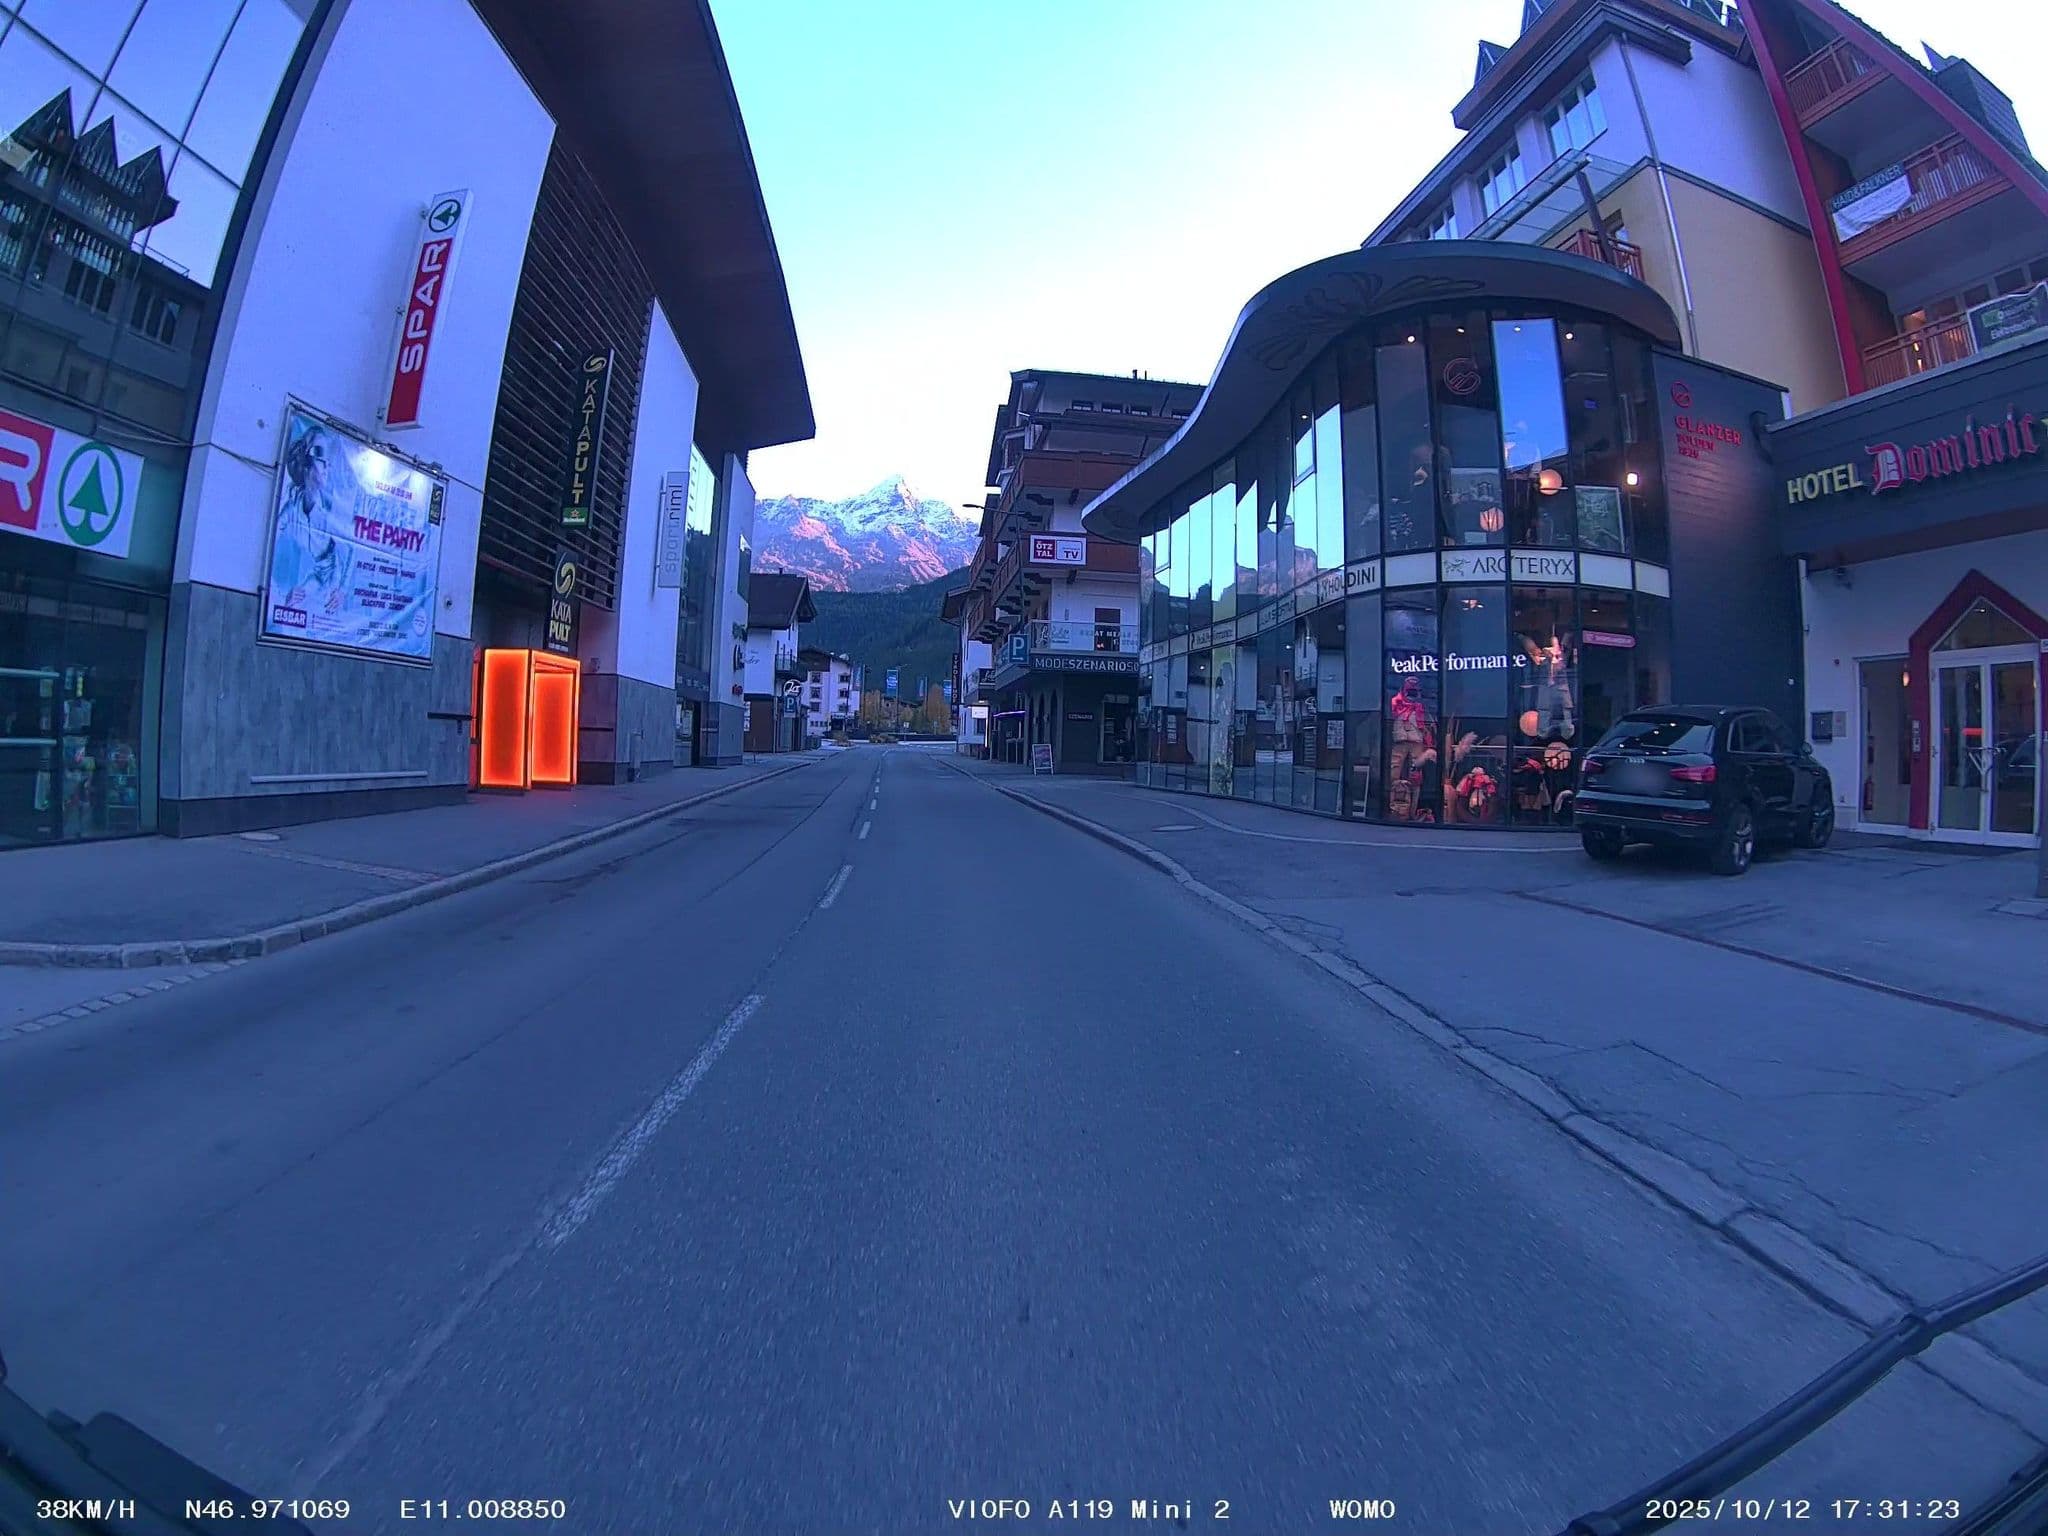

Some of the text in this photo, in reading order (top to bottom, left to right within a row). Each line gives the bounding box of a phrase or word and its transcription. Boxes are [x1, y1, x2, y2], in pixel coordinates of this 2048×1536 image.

[400, 242, 448, 374] SPAR
[572, 379, 598, 504] KATAPULT
[1675, 415, 1743, 447] GLANZER
[1787, 403, 2040, 504] HOTEL Dominic
[354, 515, 426, 552] THE PARTY
[1036, 541, 1053, 550] ÖTZ
[1064, 550, 1079, 559] TV
[1328, 566, 1375, 593] HOUDINI
[551, 599, 571, 624] KATA
[549, 620, 571, 642] PULT
[1013, 637, 1025, 655] P
[787, 697, 794, 708] P
